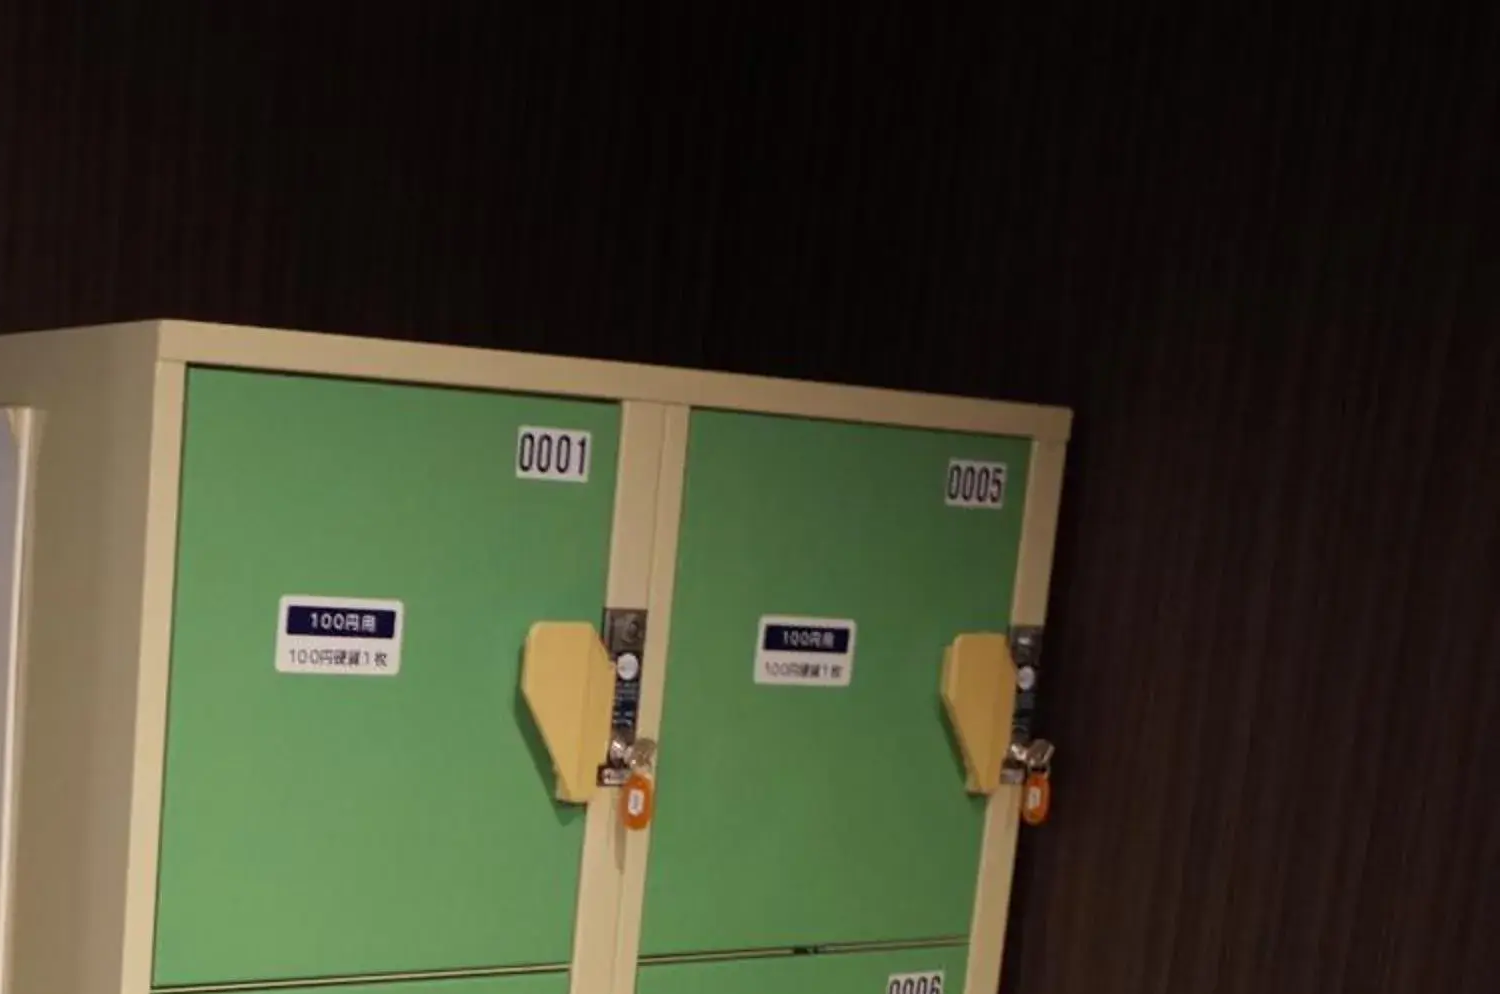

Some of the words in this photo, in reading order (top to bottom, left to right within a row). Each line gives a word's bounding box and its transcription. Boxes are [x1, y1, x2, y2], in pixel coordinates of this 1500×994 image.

[520, 432, 586, 476] 0001
[948, 464, 1002, 503] 0005
[310, 612, 377, 633] 100円用
